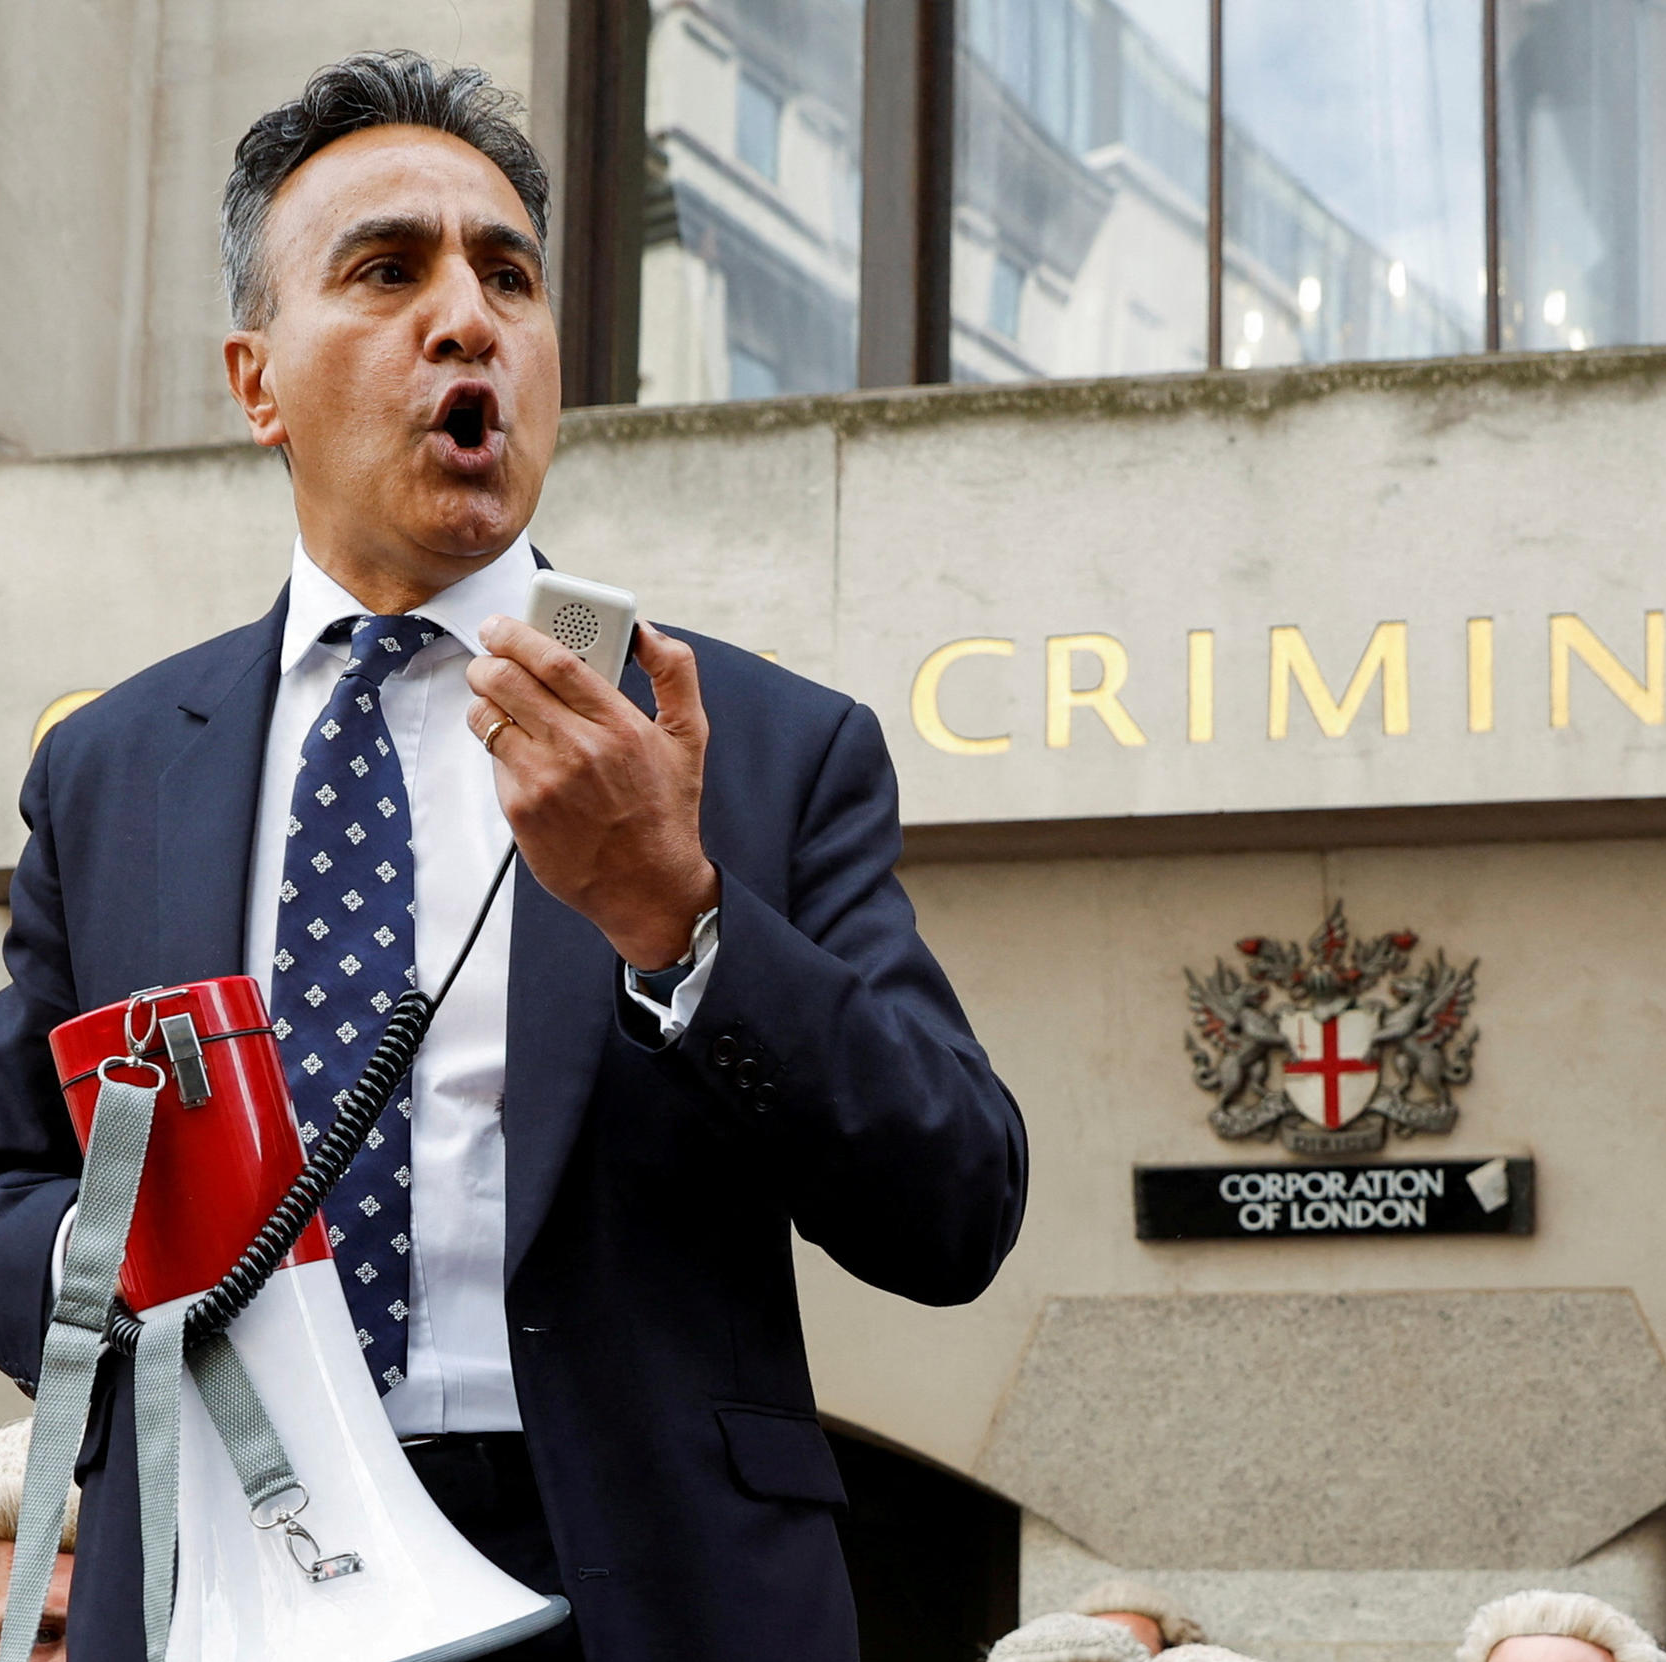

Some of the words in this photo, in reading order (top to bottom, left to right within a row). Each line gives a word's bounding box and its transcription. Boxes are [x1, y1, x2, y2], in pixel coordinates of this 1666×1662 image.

[1219, 1169, 1444, 1202] CORPORATION
[1239, 1203, 1282, 1230] OF
[1290, 1200, 1427, 1230] LONDON
